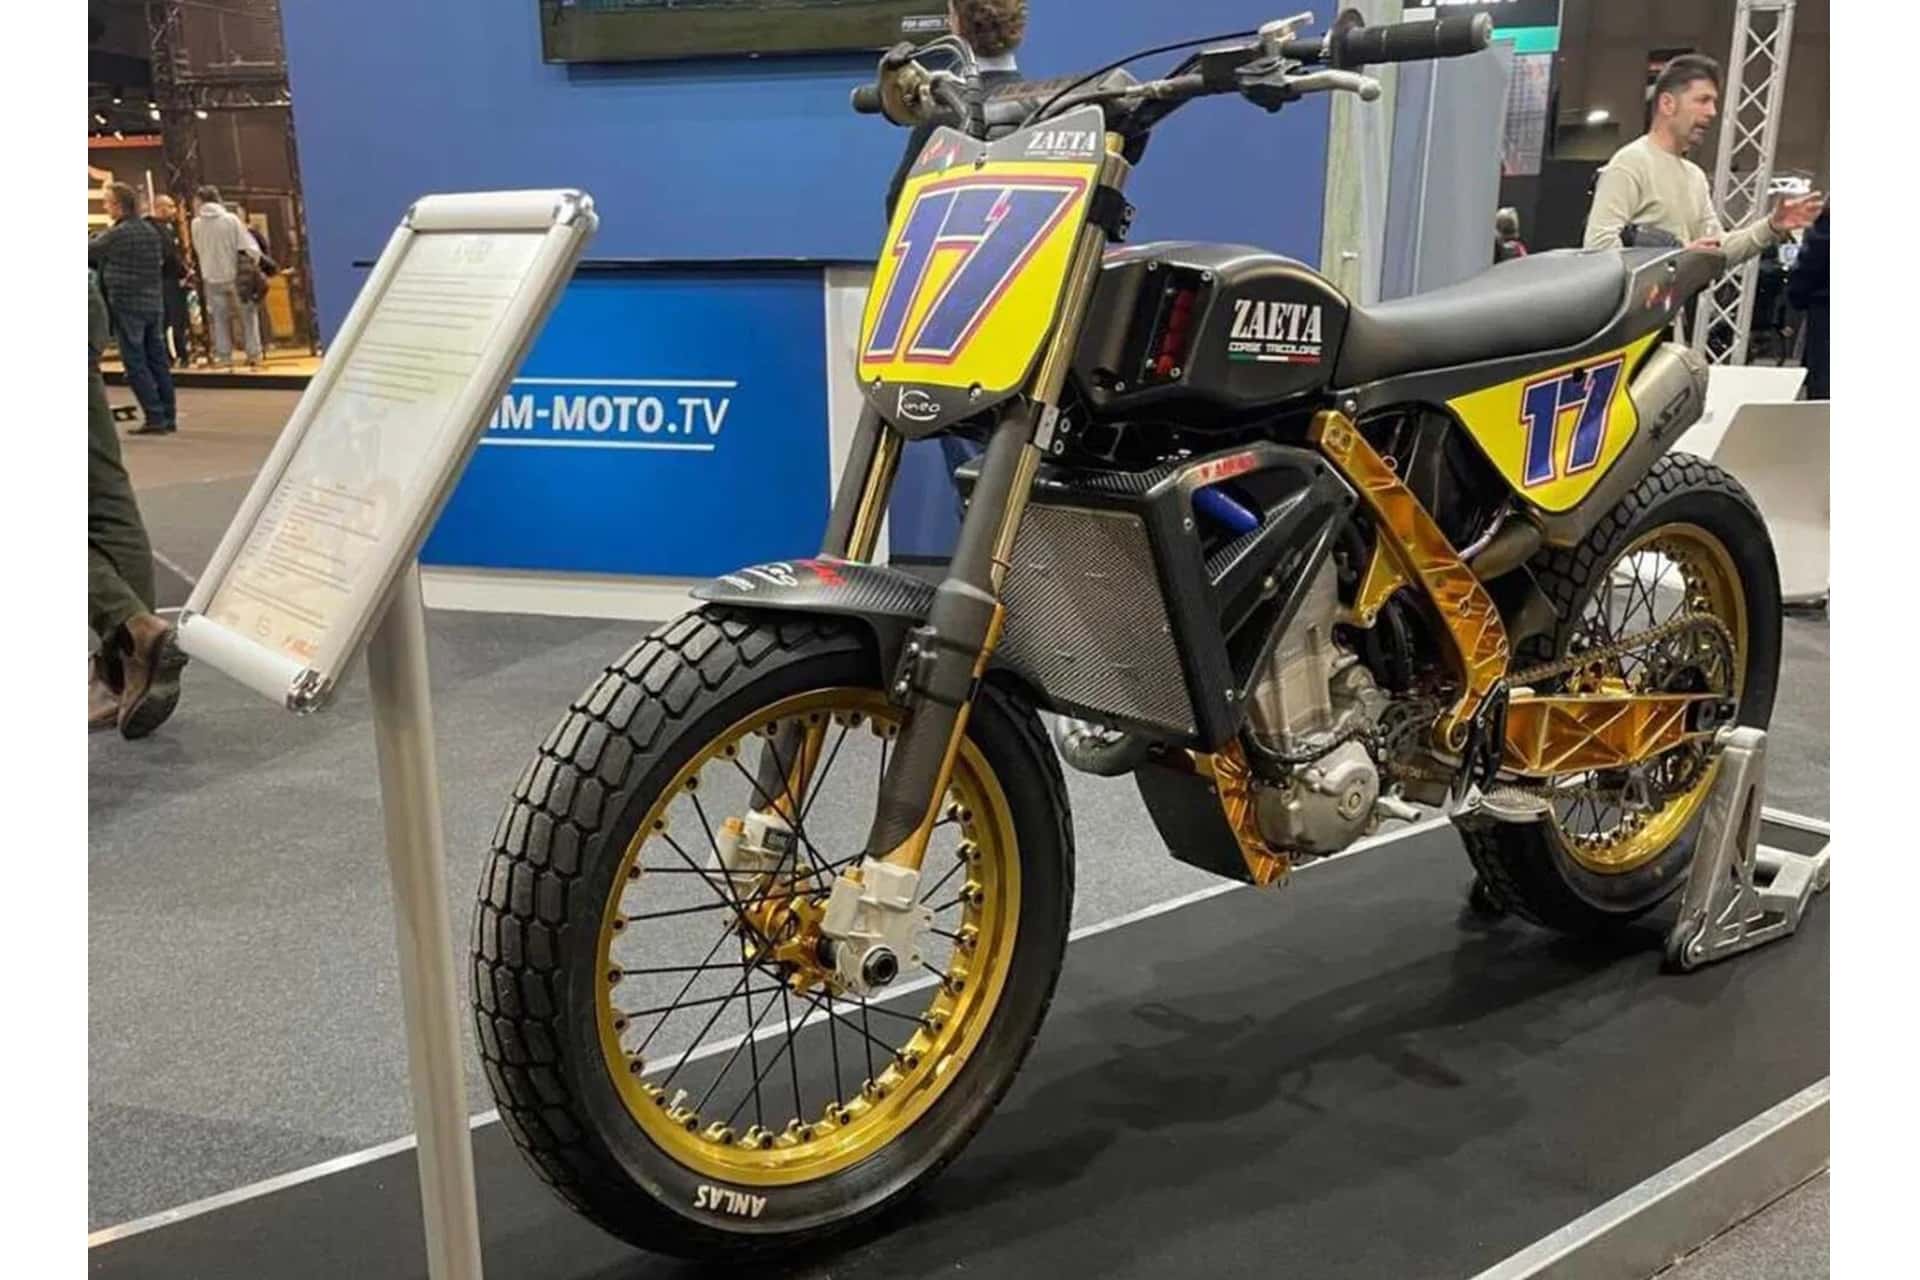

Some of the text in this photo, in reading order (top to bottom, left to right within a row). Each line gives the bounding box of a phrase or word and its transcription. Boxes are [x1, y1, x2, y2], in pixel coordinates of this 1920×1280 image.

[1028, 131, 1097, 150] ZAETA
[864, 177, 1087, 365] 17
[1230, 299, 1322, 342] ZAETA
[1520, 352, 1626, 488] 17
[693, 1184, 767, 1218] ANLAS
